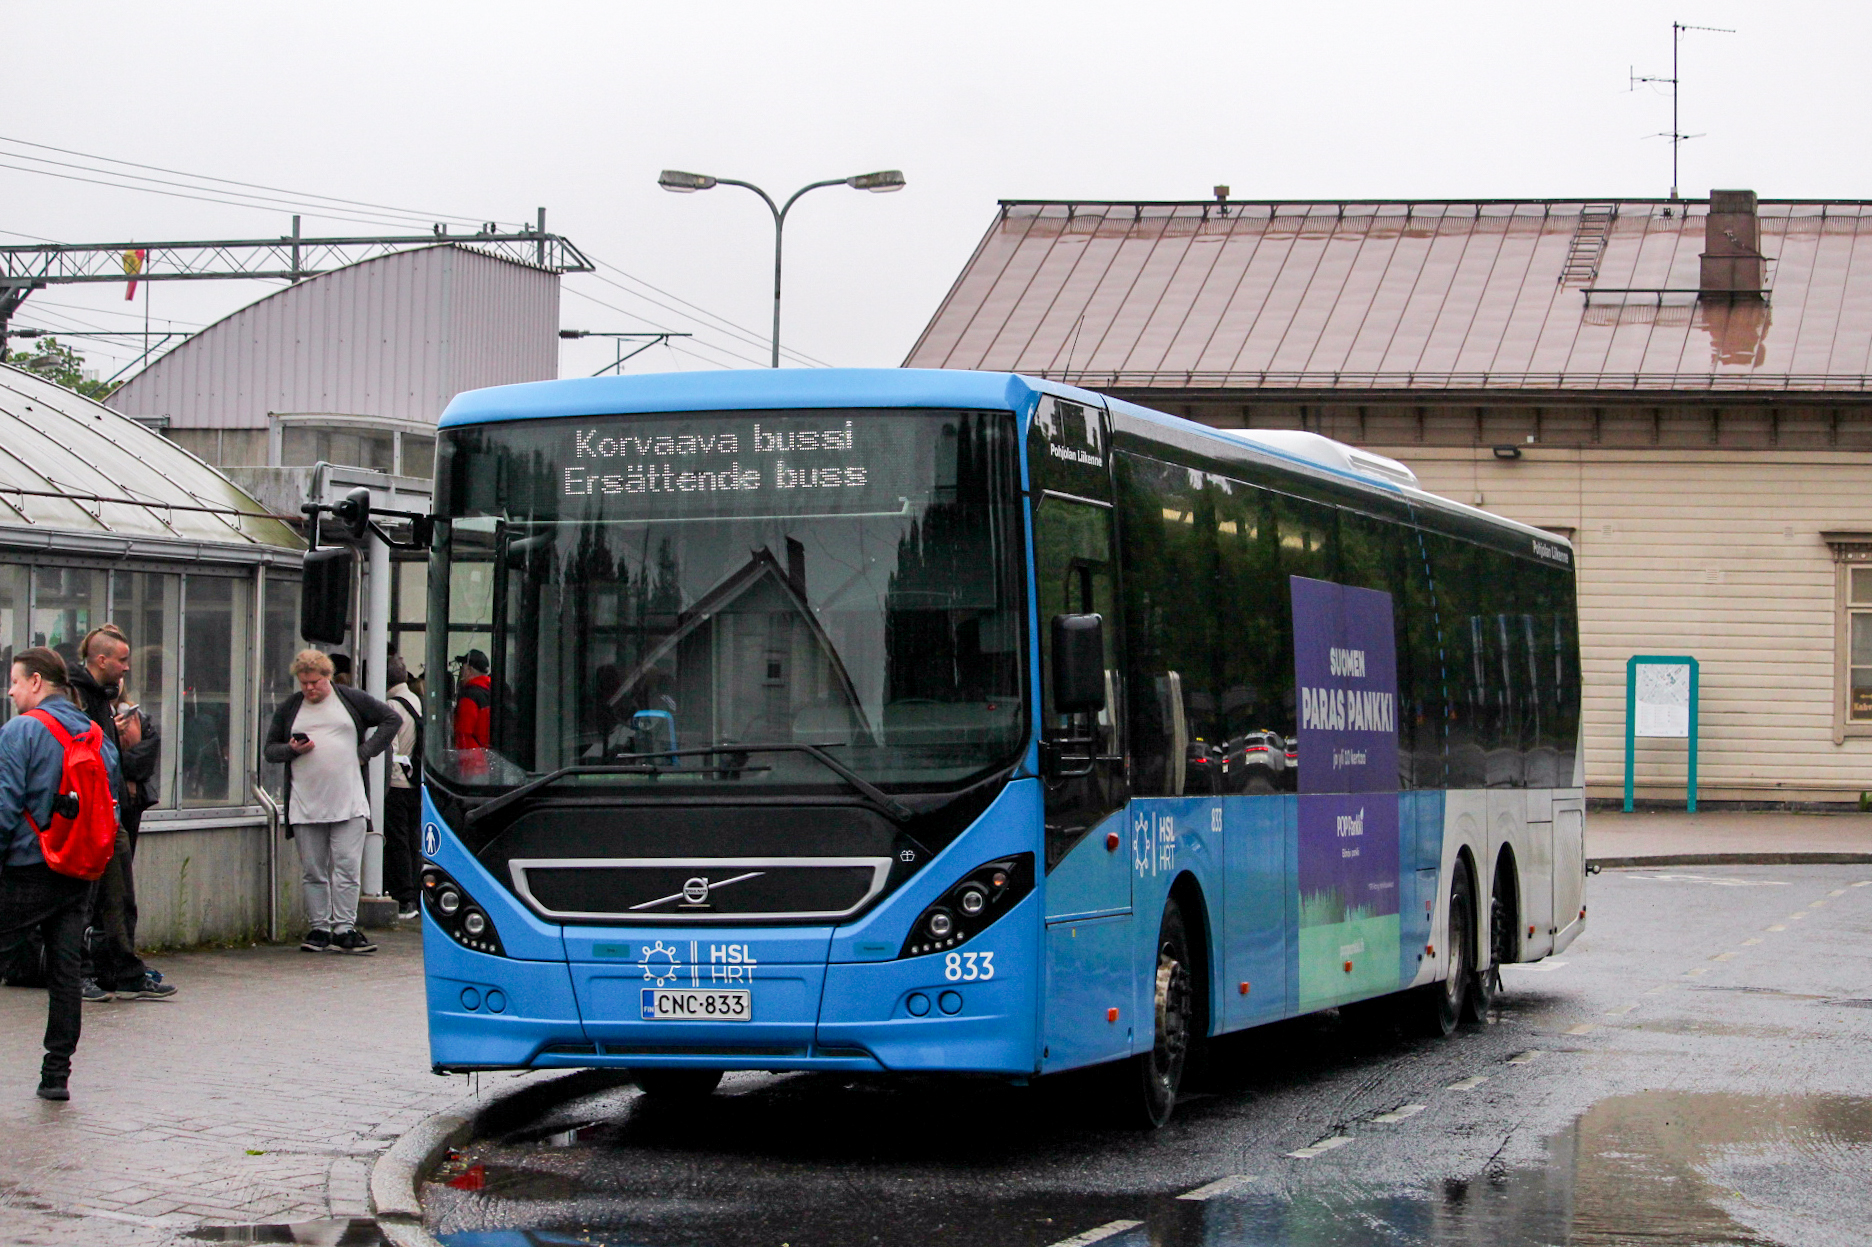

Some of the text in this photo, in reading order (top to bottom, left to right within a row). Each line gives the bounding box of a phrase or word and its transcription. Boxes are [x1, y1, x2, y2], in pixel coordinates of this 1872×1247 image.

[576, 420, 853, 458] Korvaava bussi
[1050, 442, 1103, 468] Pohjolan Liikenne
[564, 459, 868, 495] Ersättende buss
[1330, 647, 1366, 678] SUOMEN
[1301, 686, 1394, 732] PARAS PANKKI
[1159, 816, 1175, 842] HSL
[1211, 808, 1222, 832] 833
[1336, 815, 1349, 837] POP
[1159, 844, 1175, 871] HRT
[711, 944, 757, 964] HSL
[944, 951, 994, 981] 833
[711, 965, 757, 984] HRT
[643, 1005, 655, 1014] FIN
[658, 994, 745, 1015] CNC-833
